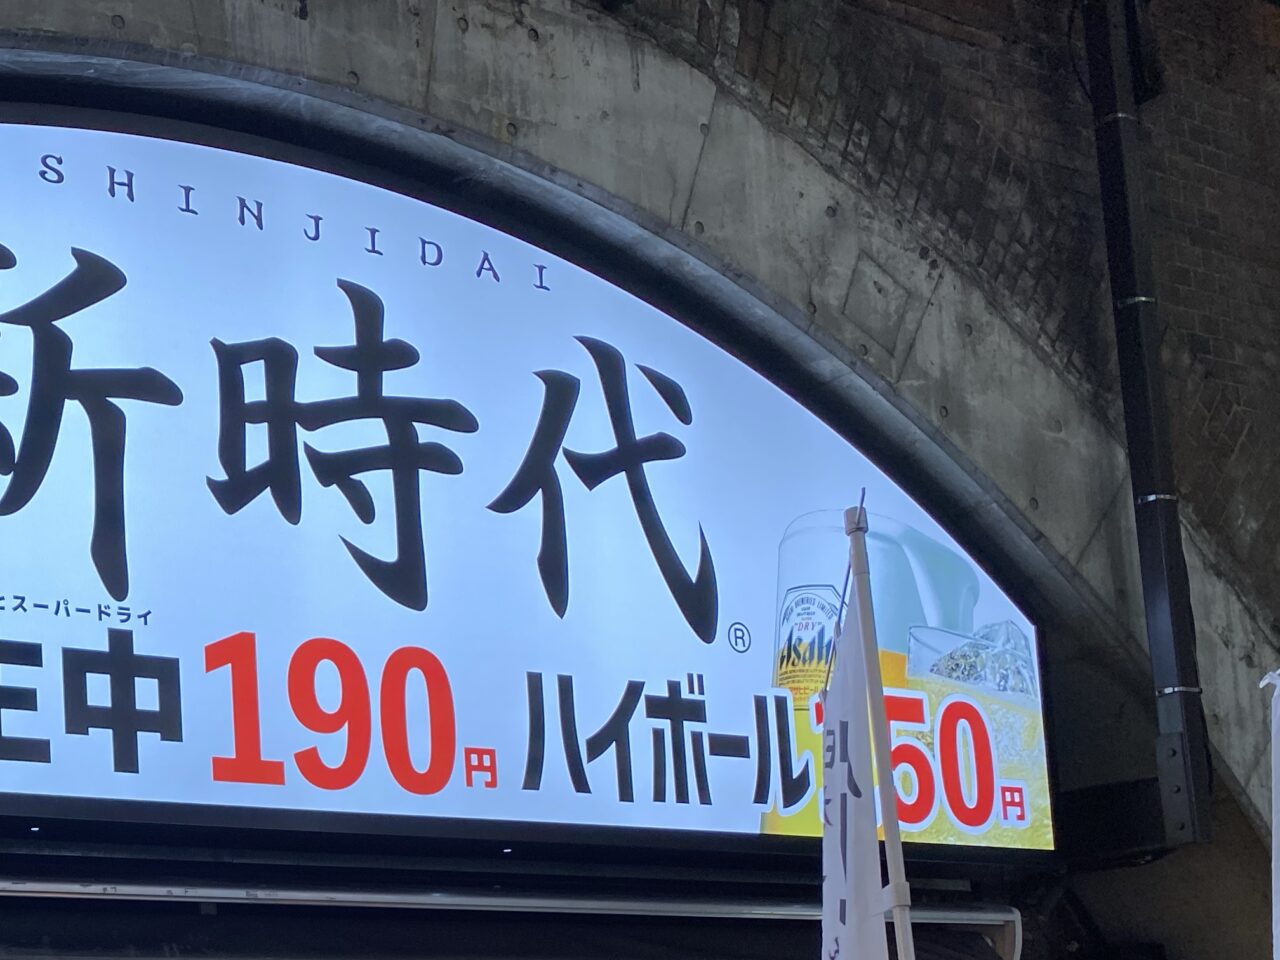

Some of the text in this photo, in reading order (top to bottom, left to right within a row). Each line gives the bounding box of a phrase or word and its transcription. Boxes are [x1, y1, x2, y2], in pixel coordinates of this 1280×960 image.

[38, 152, 553, 292] SHINJIDAI
[520, 670, 811, 810] ハイボール
[814, 694, 1026, 828] 50円
